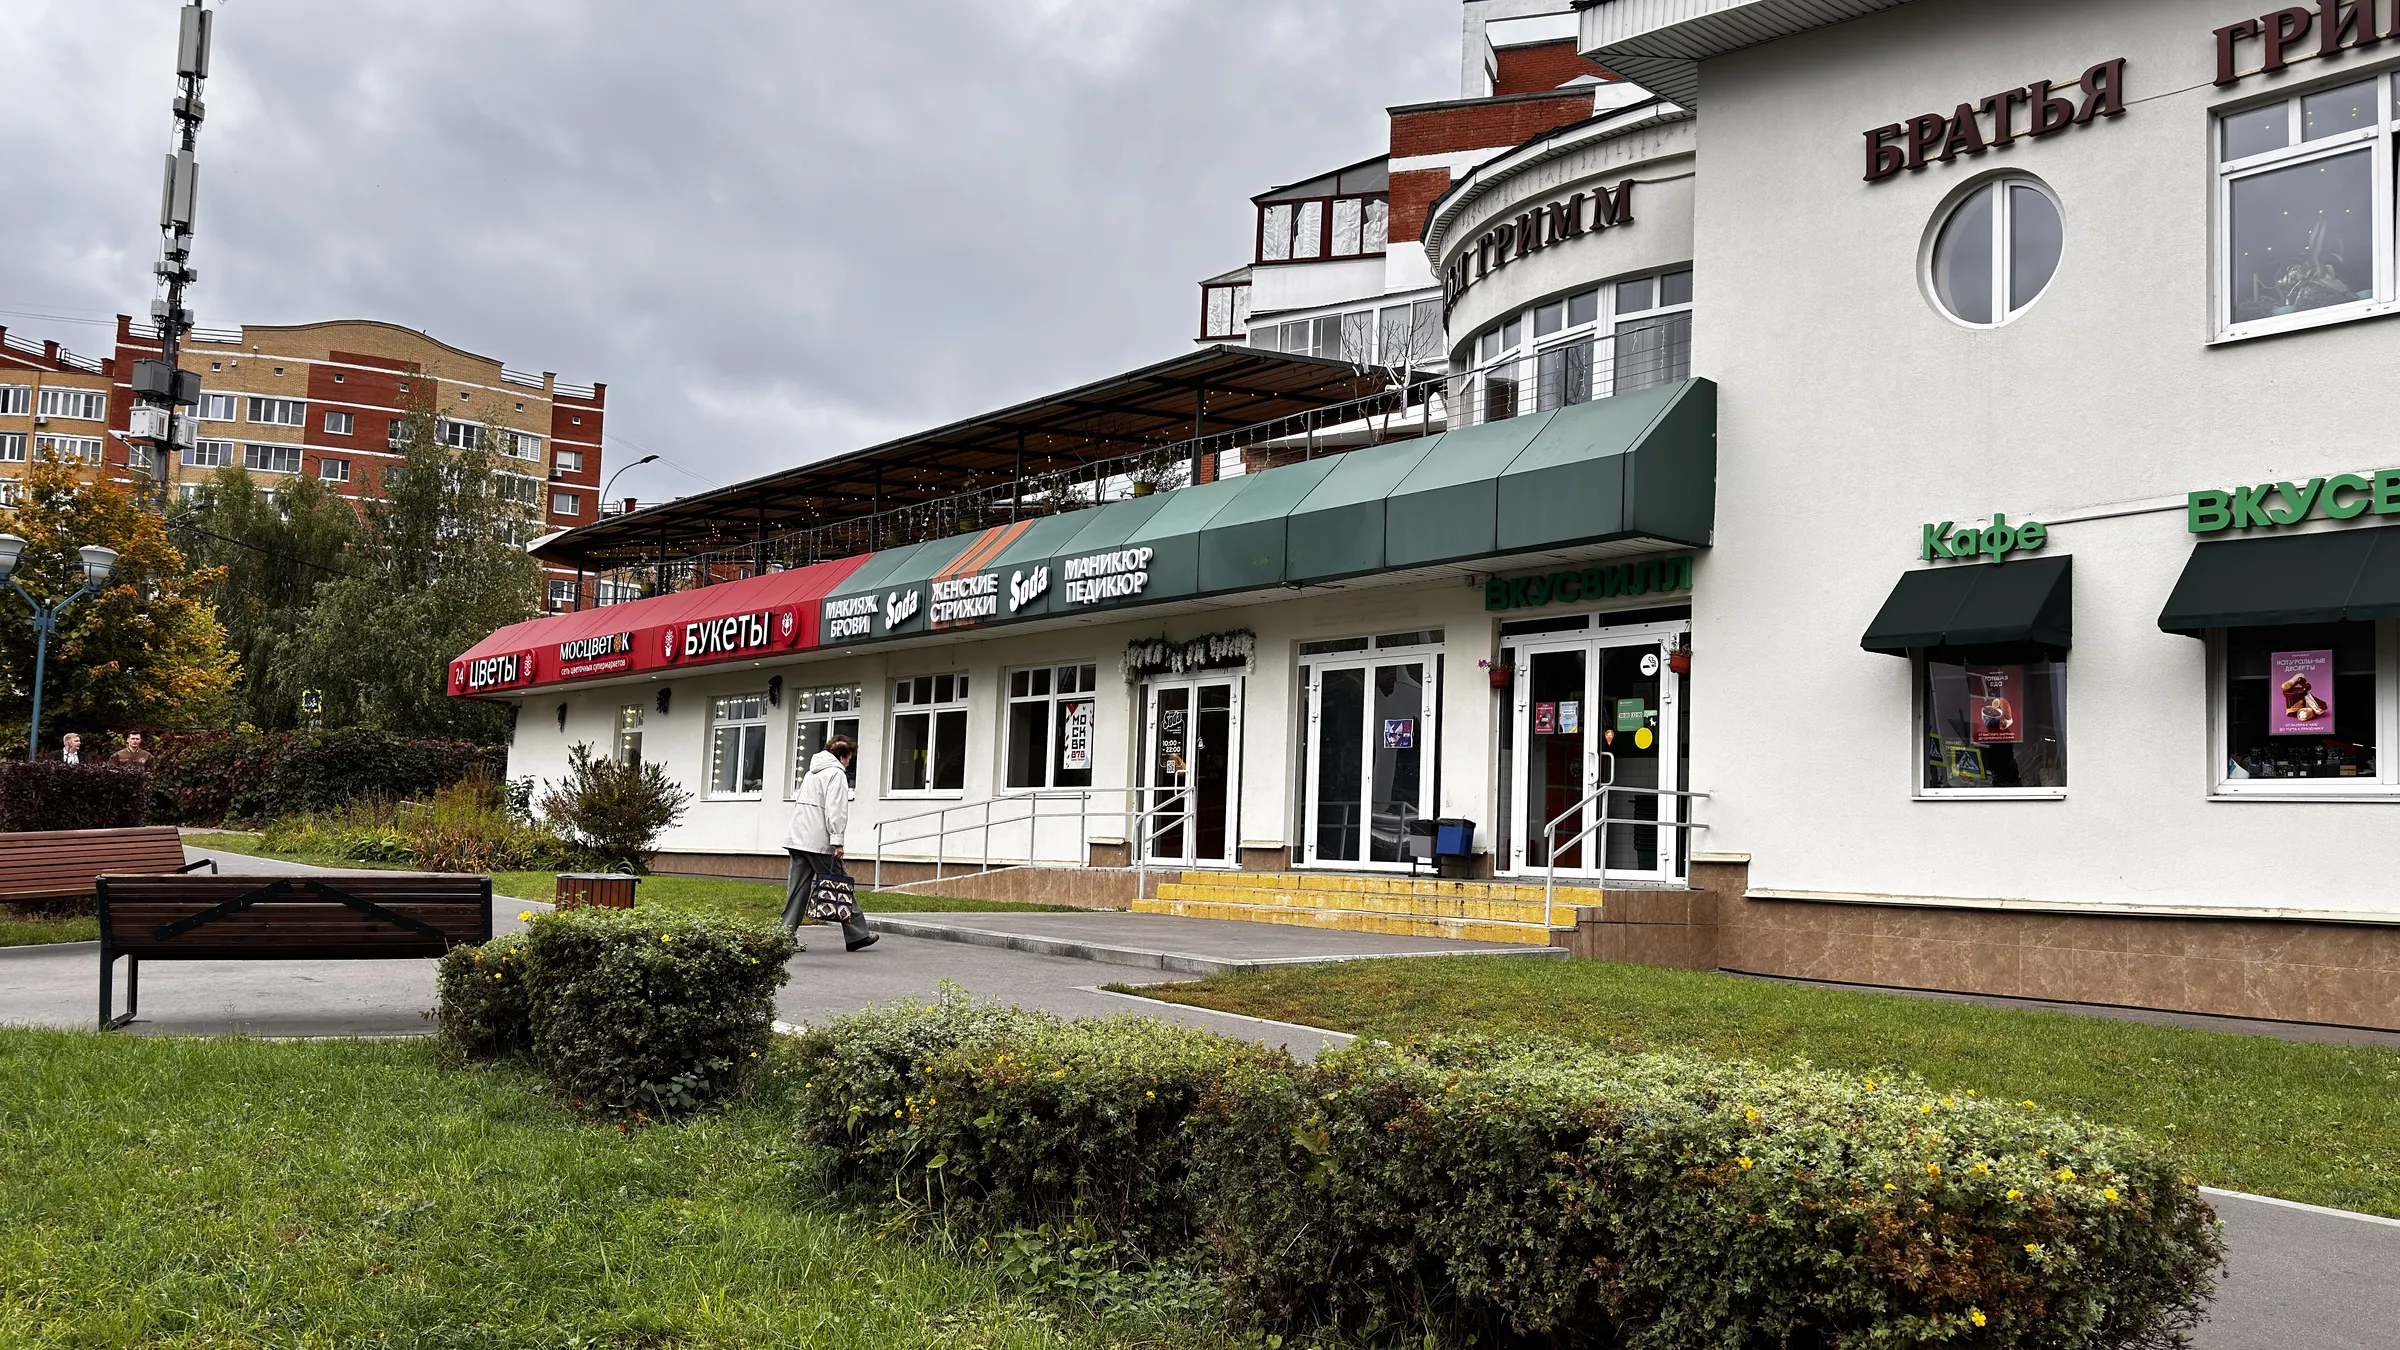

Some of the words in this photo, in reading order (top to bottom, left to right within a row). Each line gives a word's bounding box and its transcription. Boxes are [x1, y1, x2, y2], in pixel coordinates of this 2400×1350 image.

[1863, 57, 2127, 182] БРАТЬЯ
[2212, 0, 2400, 87] ГРИ
[1475, 178, 1635, 278] ГРИММ
[1922, 513, 2048, 564] Кафе
[1064, 547, 1153, 581] МАНИКЮР
[931, 573, 999, 602] ЖЕНСКИЕ
[1009, 565, 1049, 613] Soda
[1065, 572, 1149, 604] ПЕДИКЮР
[1485, 556, 1693, 611] ВКУСВИЛЛ
[825, 595, 879, 620] МАКИЯЖ
[885, 589, 919, 630] Soda
[930, 595, 997, 623] СТРИЖКИ
[830, 616, 871, 638] БРОВИ
[455, 668, 464, 685] 24
[561, 668, 570, 676] сеть
[570, 664, 593, 675] цветочных
[593, 659, 626, 673] супермаркетов
